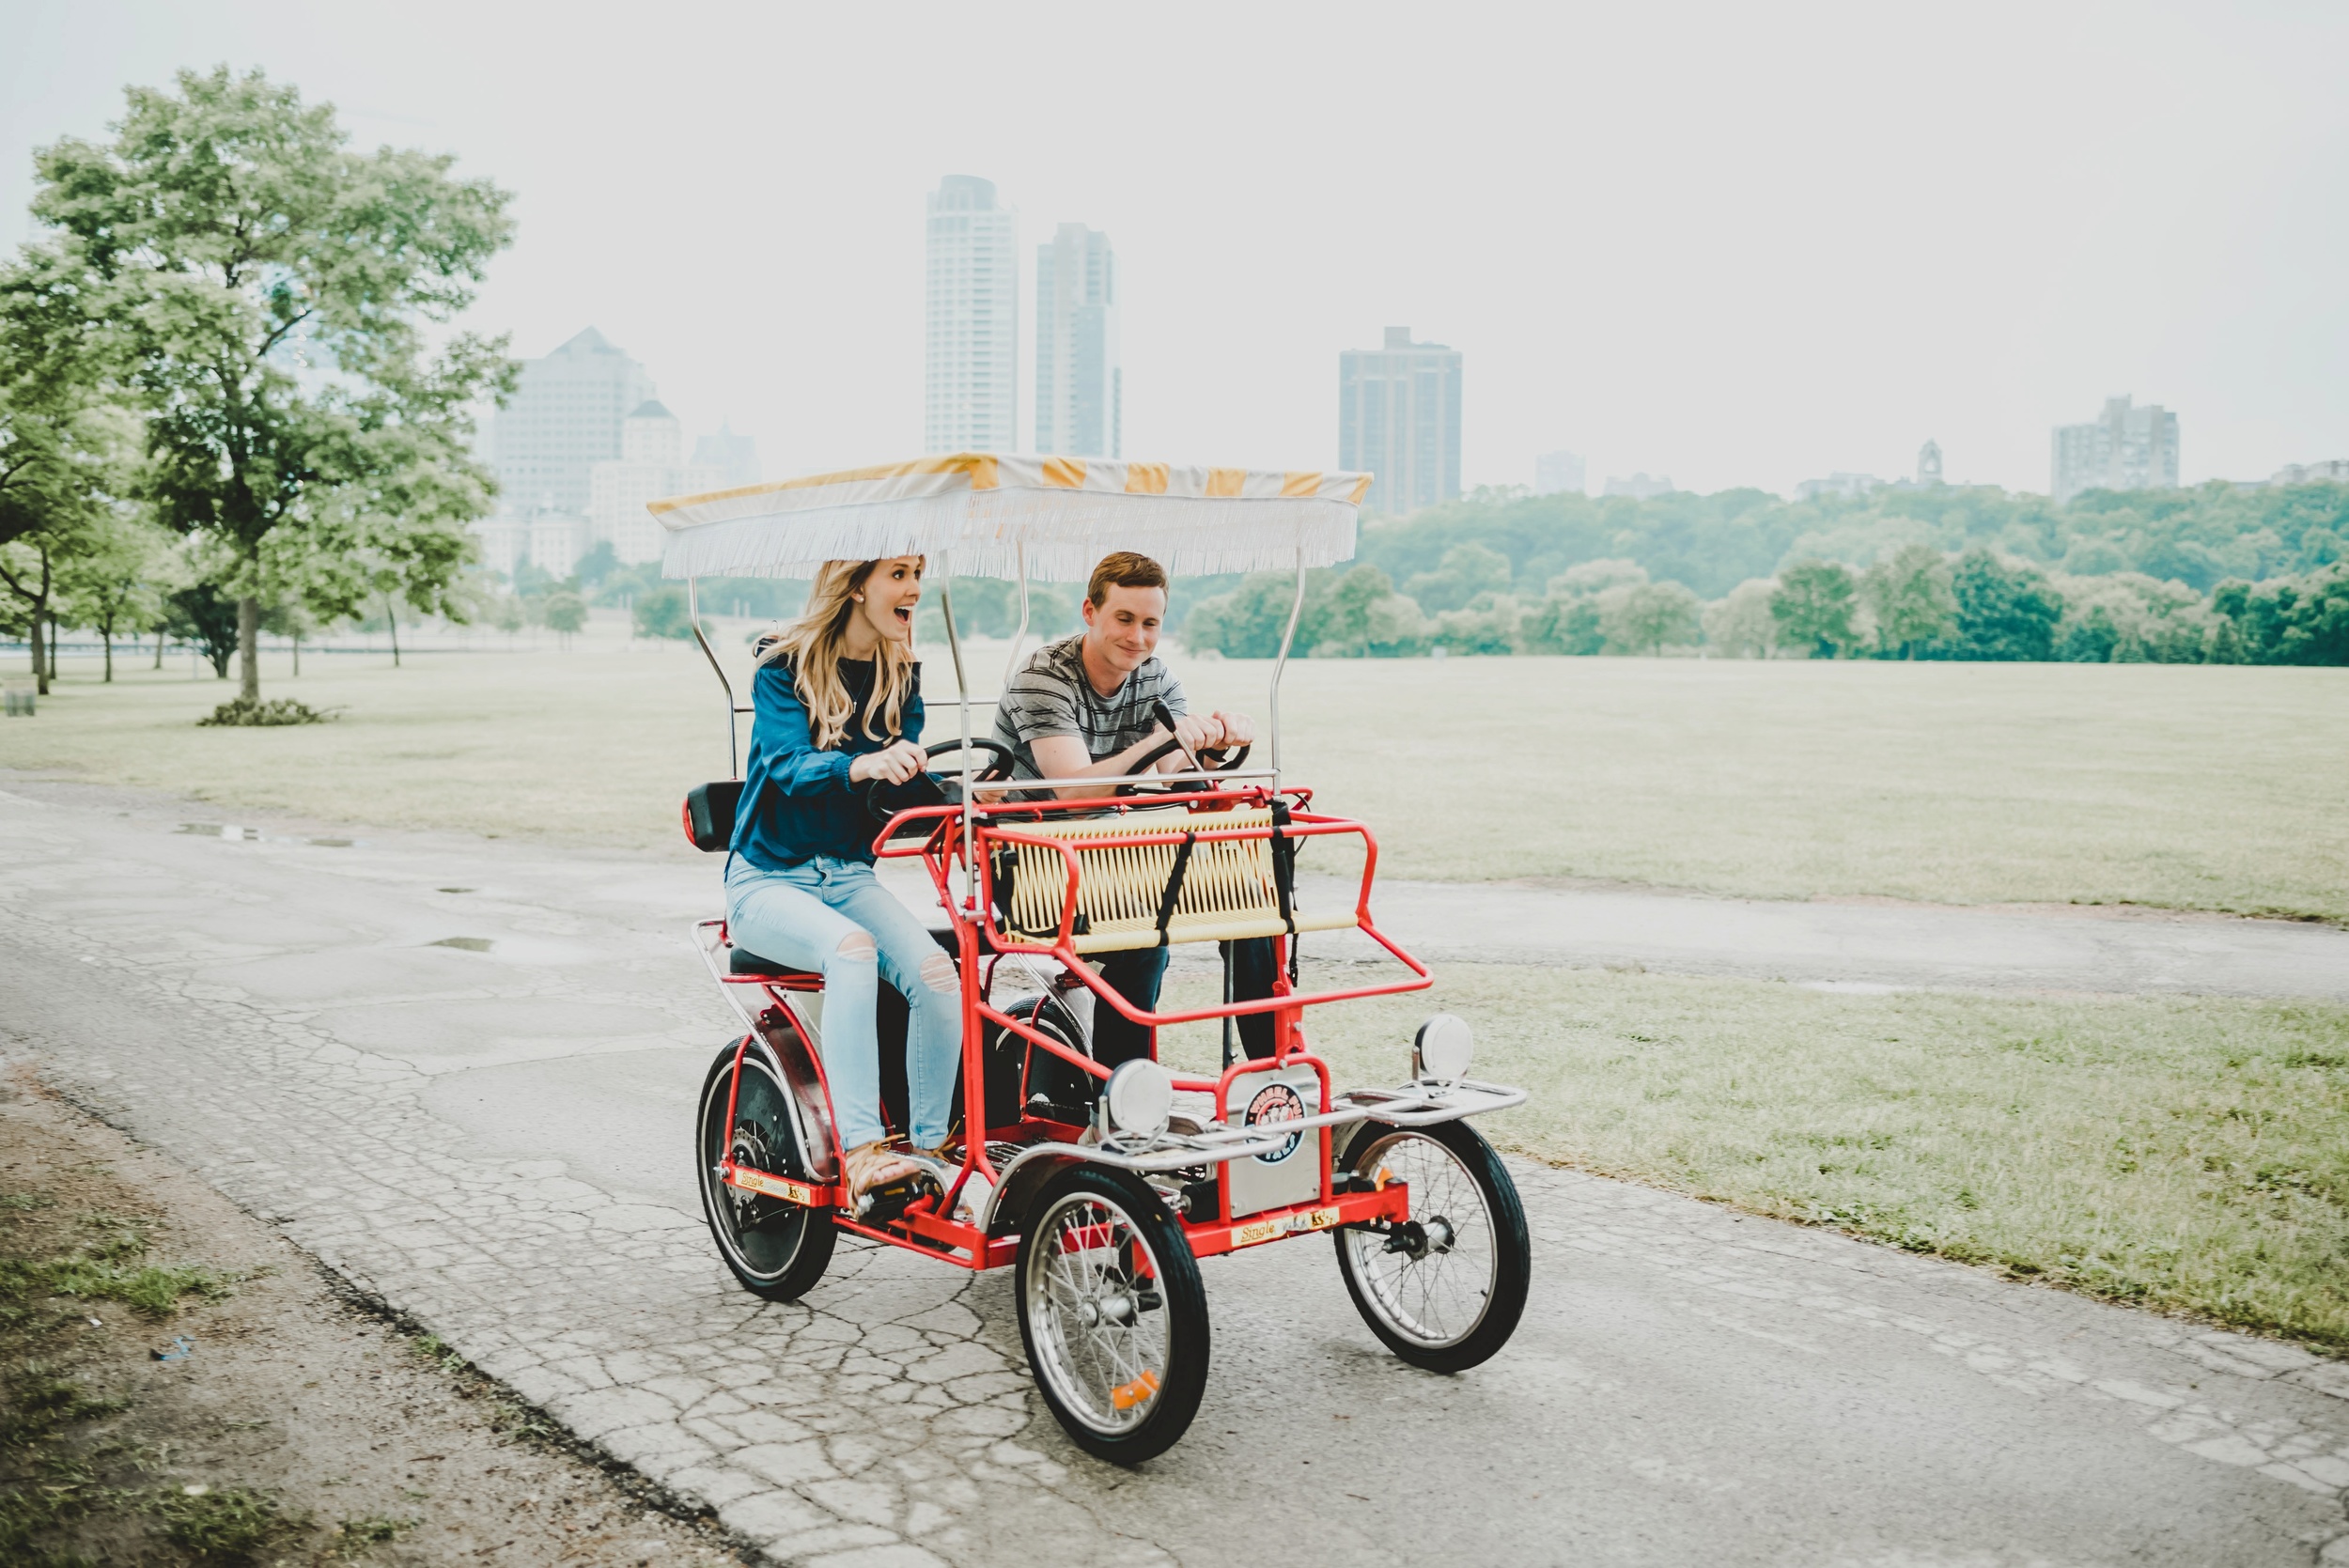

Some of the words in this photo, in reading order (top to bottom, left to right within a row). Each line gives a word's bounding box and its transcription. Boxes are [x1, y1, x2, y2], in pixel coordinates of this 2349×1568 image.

[1249, 1086, 1289, 1114] WHEEL
[741, 1172, 764, 1188] Single
[1240, 1221, 1275, 1243] Single
